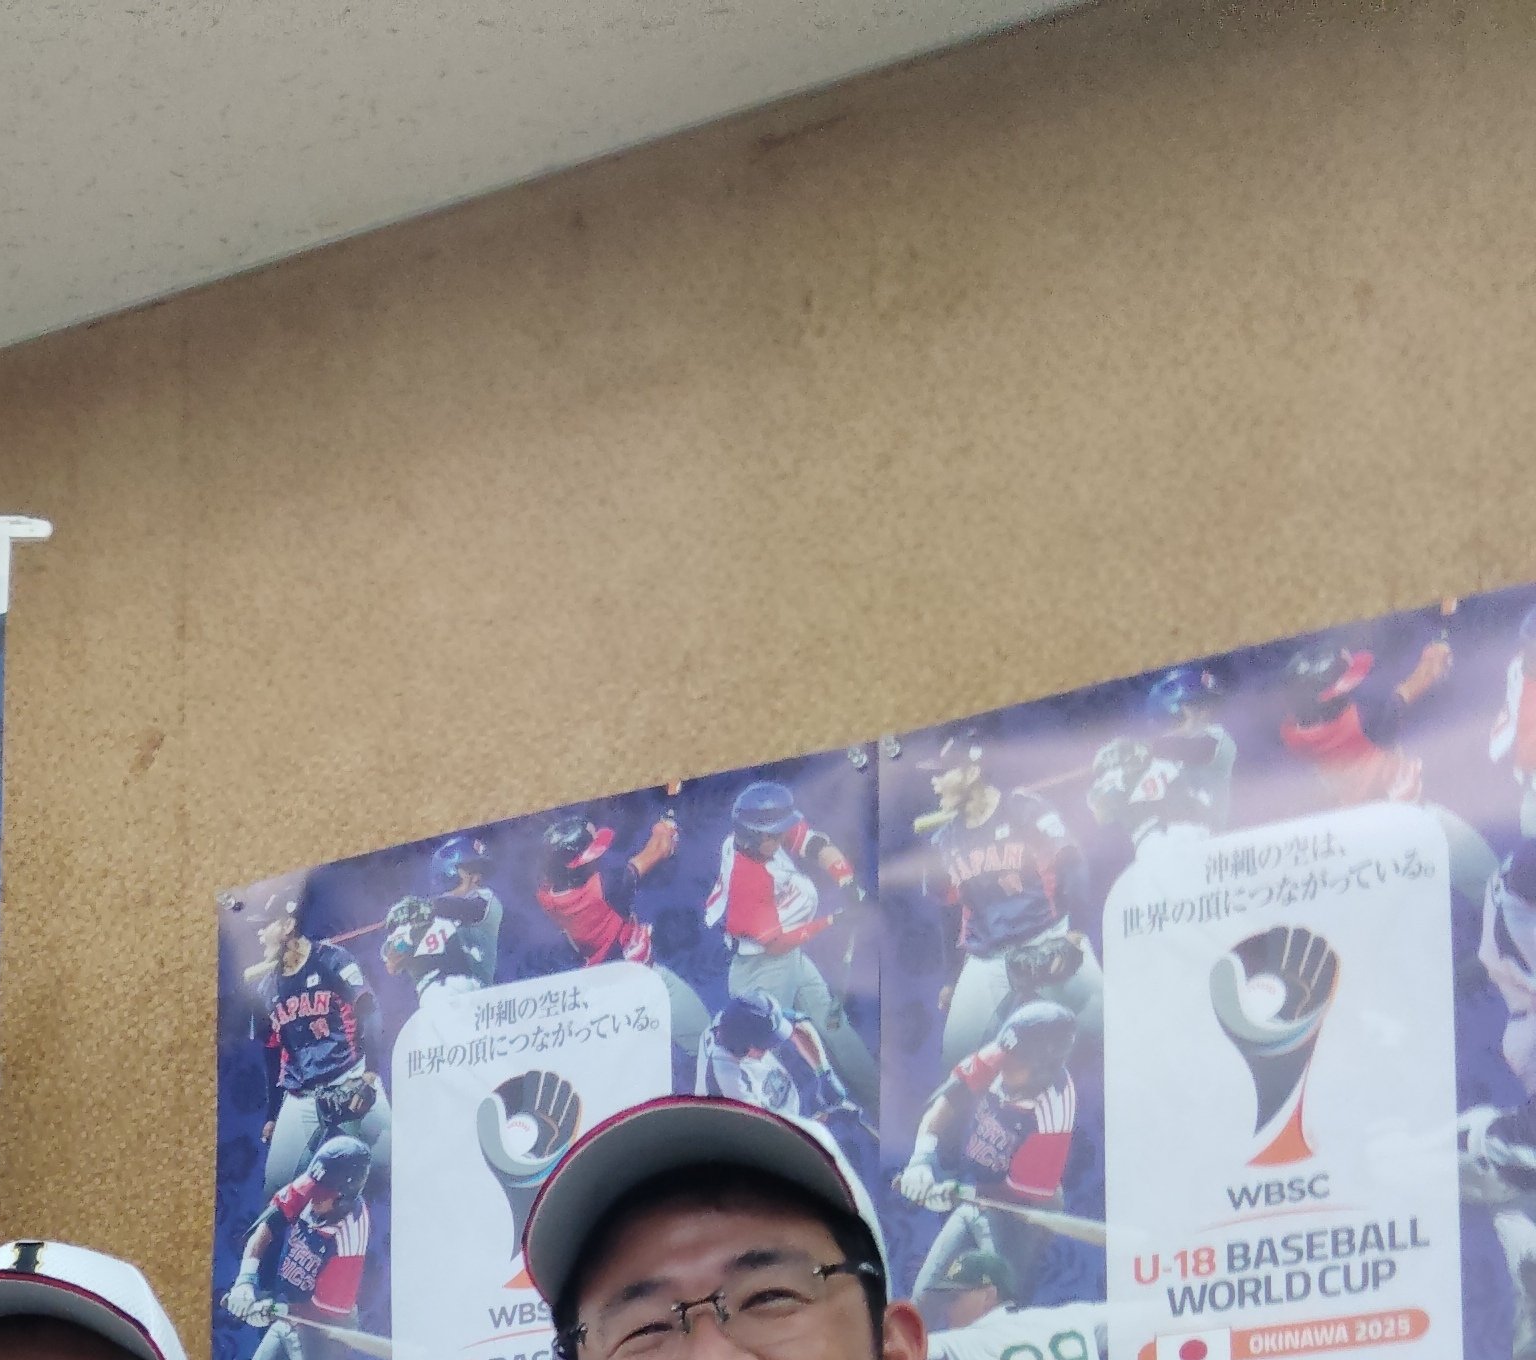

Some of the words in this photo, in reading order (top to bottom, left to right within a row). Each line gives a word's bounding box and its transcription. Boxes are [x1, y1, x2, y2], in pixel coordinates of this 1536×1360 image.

[474, 985, 589, 1031] 沖縄の空は、
[407, 1006, 660, 1079] 世界の頂につながっている。
[1226, 1173, 1331, 1211] WBSC
[1134, 1246, 1217, 1286] U-18
[1226, 1216, 1431, 1274] BASEBALL
[1166, 1271, 1312, 1318] WORLD
[1318, 1259, 1397, 1298] CUP
[488, 1301, 552, 1329] WBS
[1249, 1323, 1349, 1356] OKINAWA
[1354, 1314, 1411, 1341] 2025
